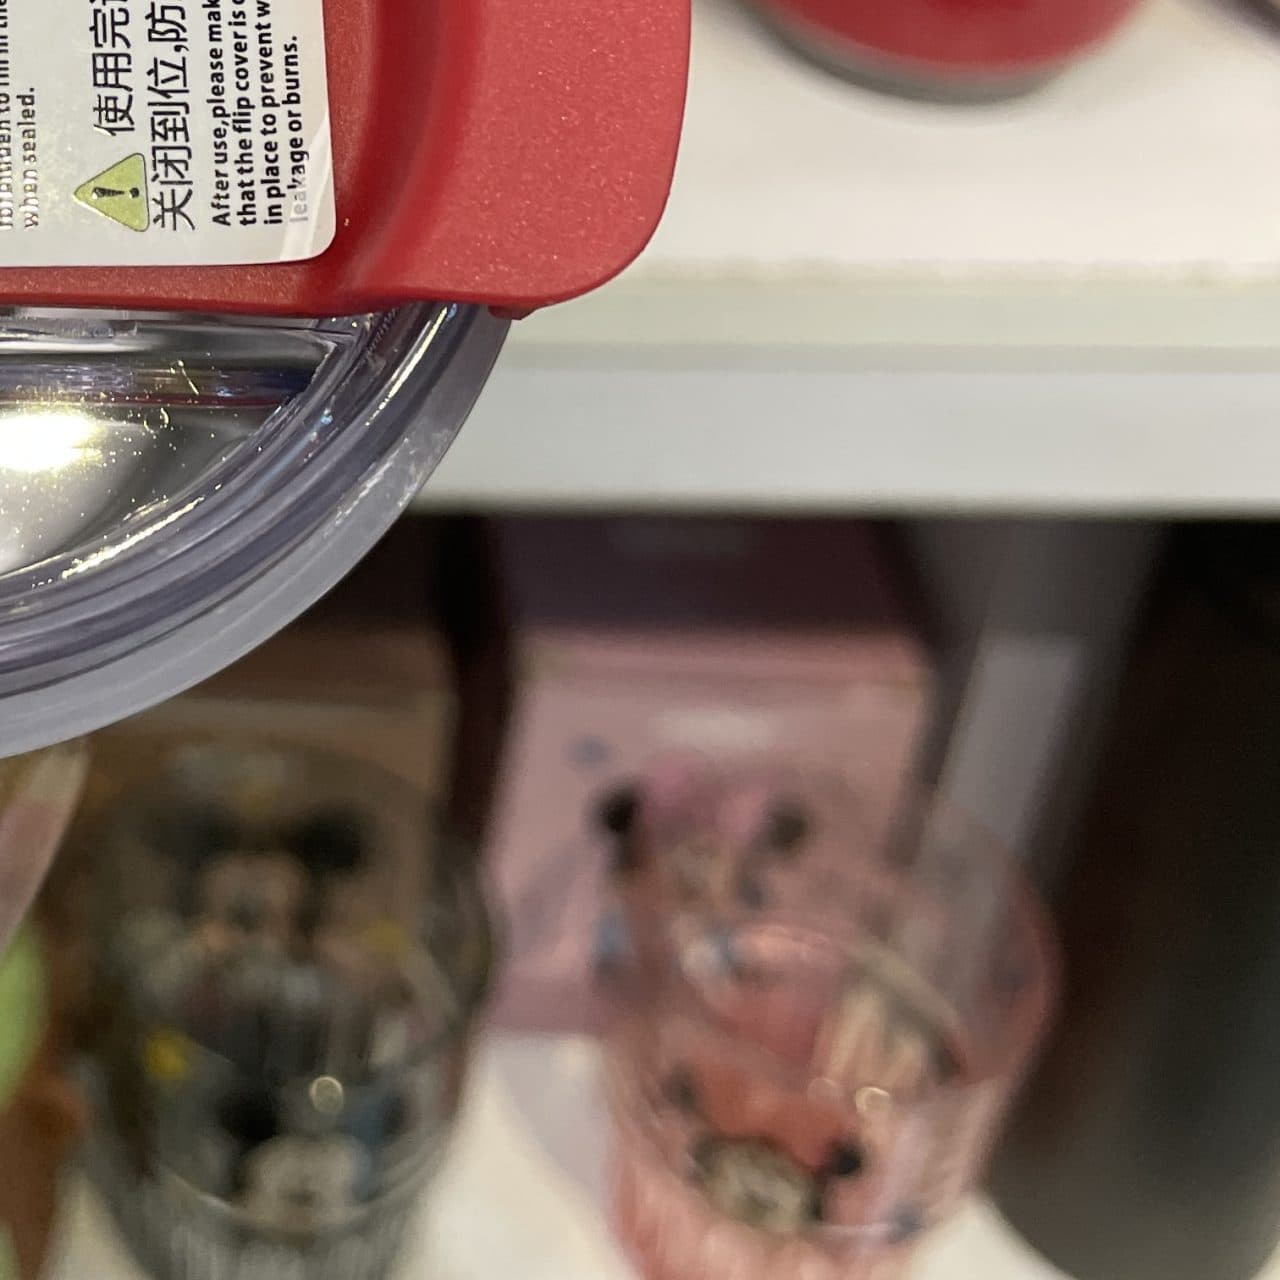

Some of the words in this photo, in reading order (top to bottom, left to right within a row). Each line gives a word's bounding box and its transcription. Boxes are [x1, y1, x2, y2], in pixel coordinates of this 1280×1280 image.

[229, 11, 247, 26] is
[233, 32, 250, 91] cover
[255, 23, 279, 108] prevent
[283, 36, 301, 105] burns.
[17, 87, 36, 163] sealed.
[234, 97, 254, 133] flip
[260, 114, 277, 134] to
[285, 110, 302, 131] or
[236, 138, 254, 174] the
[261, 141, 285, 197] place
[288, 137, 309, 222] leakage
[18, 169, 38, 229] when
[211, 170, 231, 226] After
[238, 180, 257, 226] that
[264, 204, 283, 224] in
